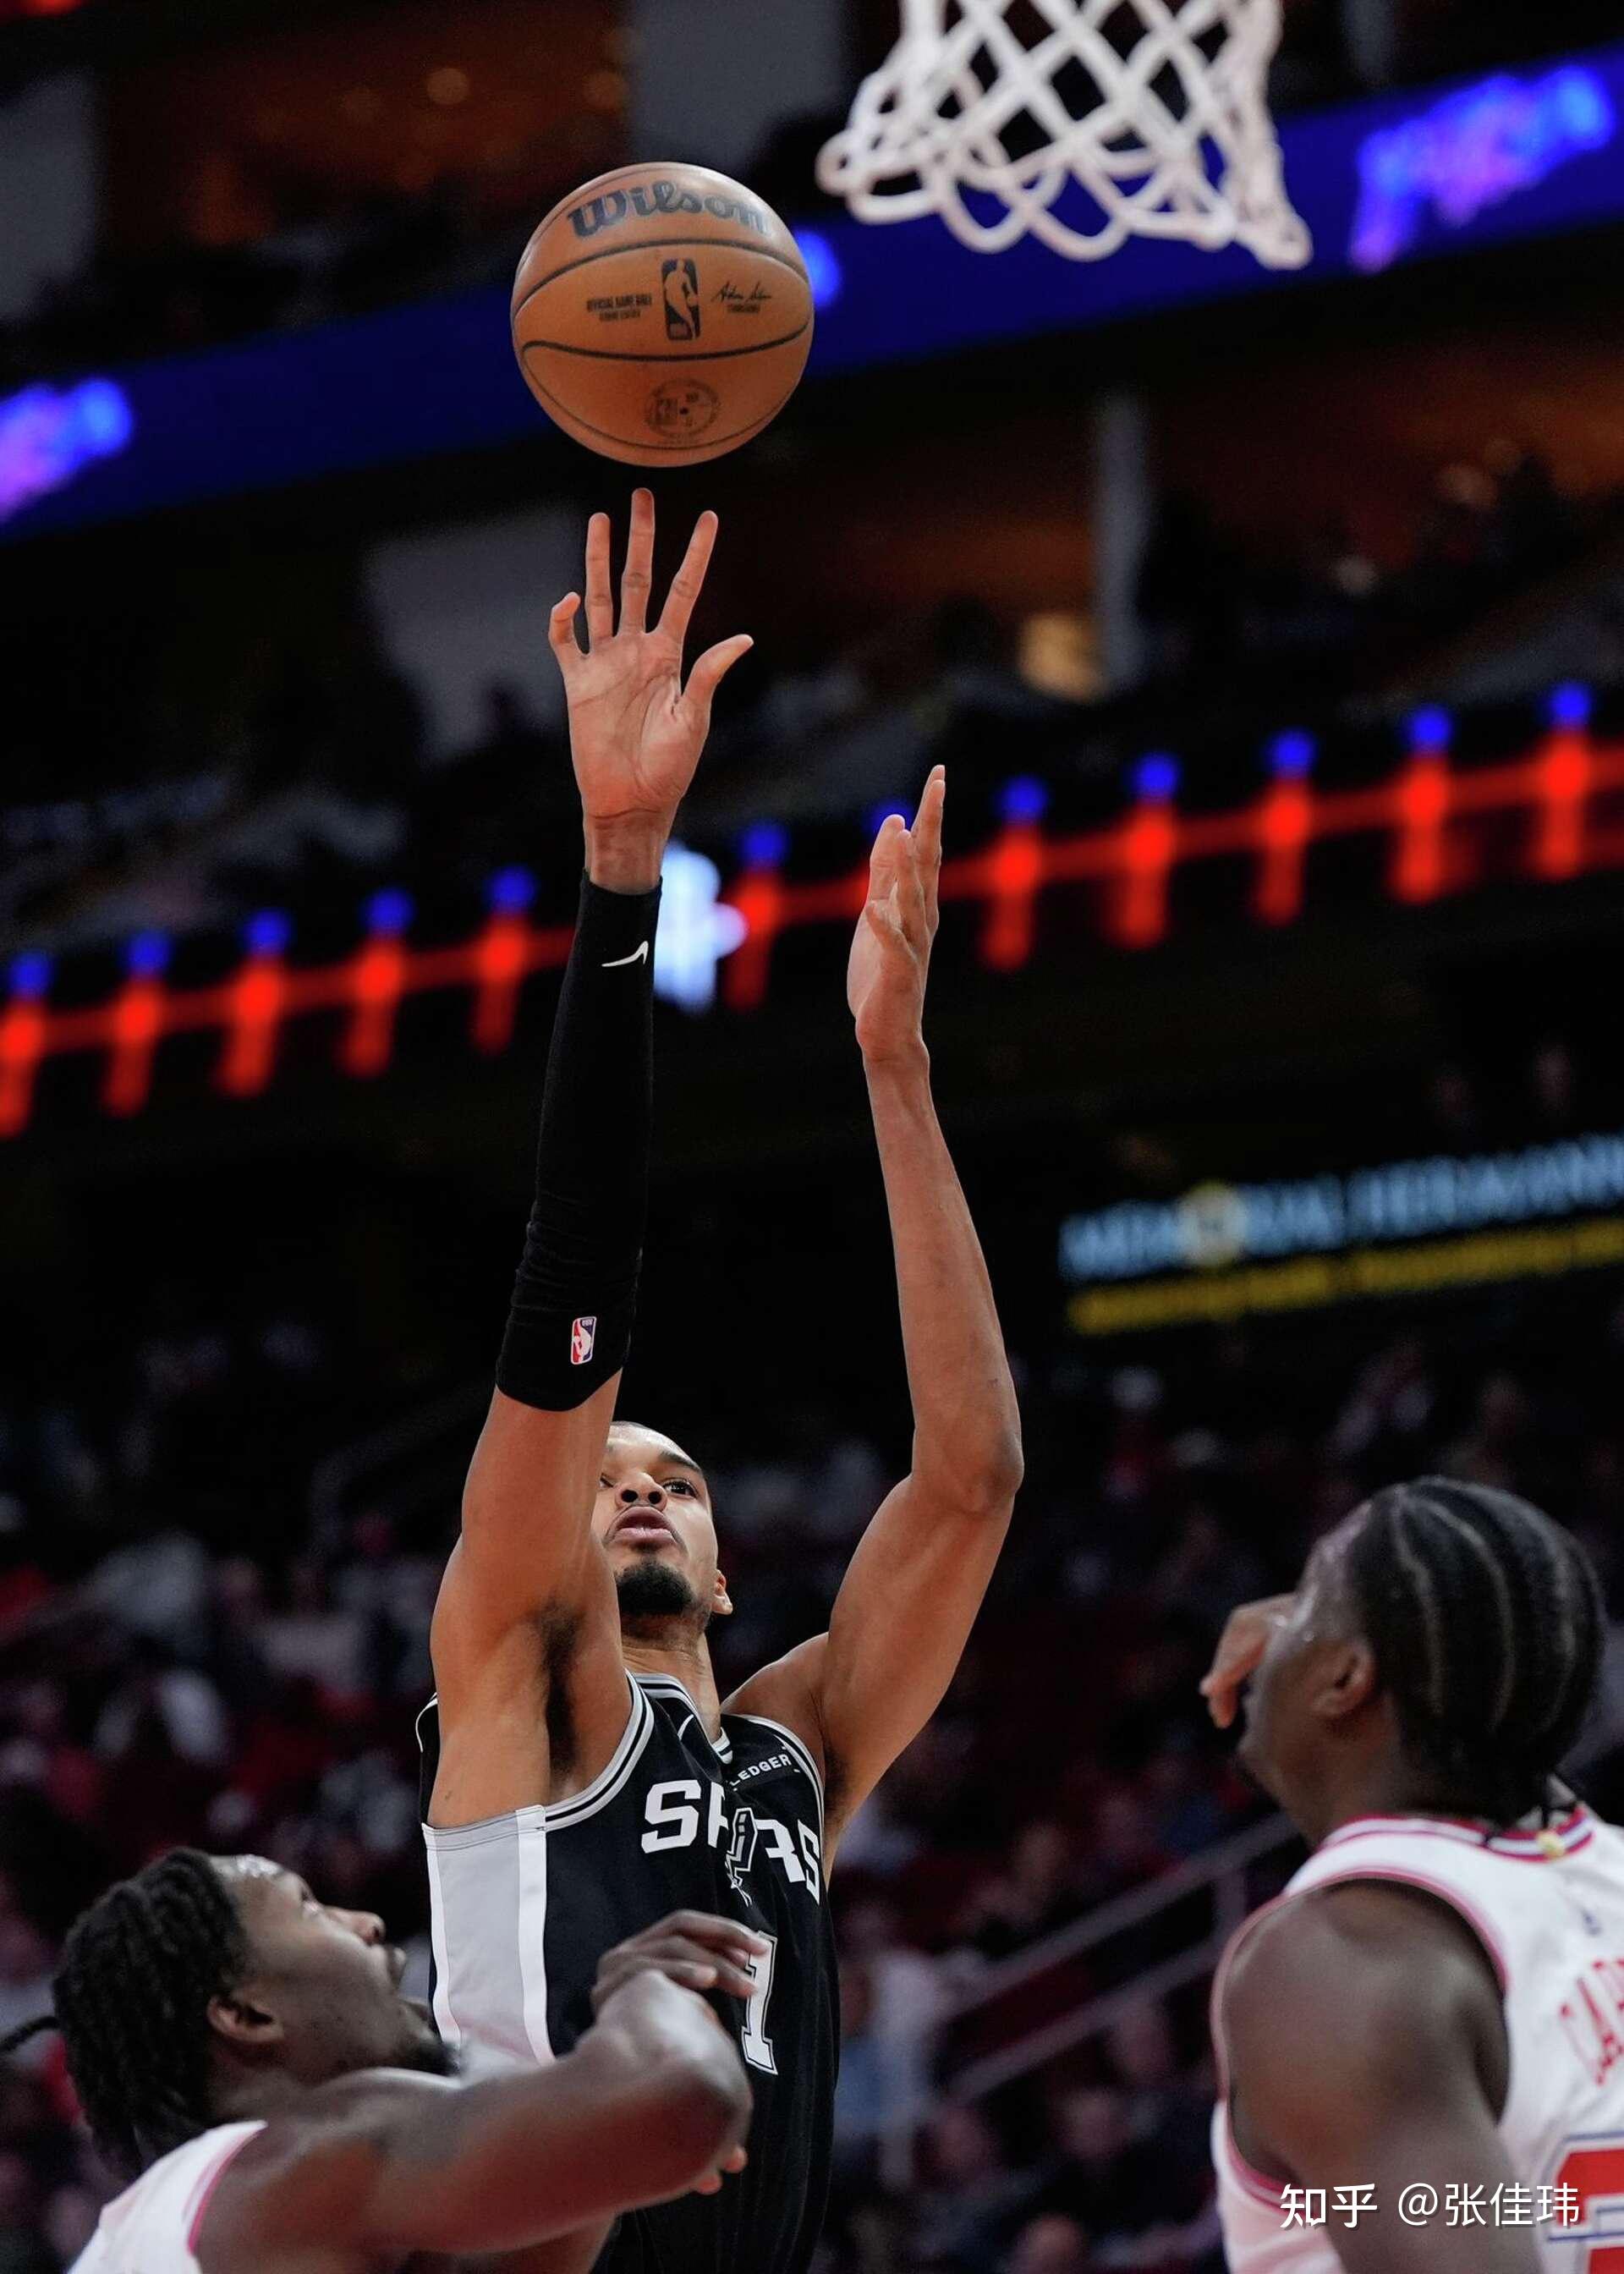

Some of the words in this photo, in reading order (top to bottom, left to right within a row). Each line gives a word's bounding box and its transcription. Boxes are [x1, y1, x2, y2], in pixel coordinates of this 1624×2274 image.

[568, 181, 771, 237] Wilson
[729, 1754, 792, 1787] LEDGER
[742, 1931, 777, 2075] 1
